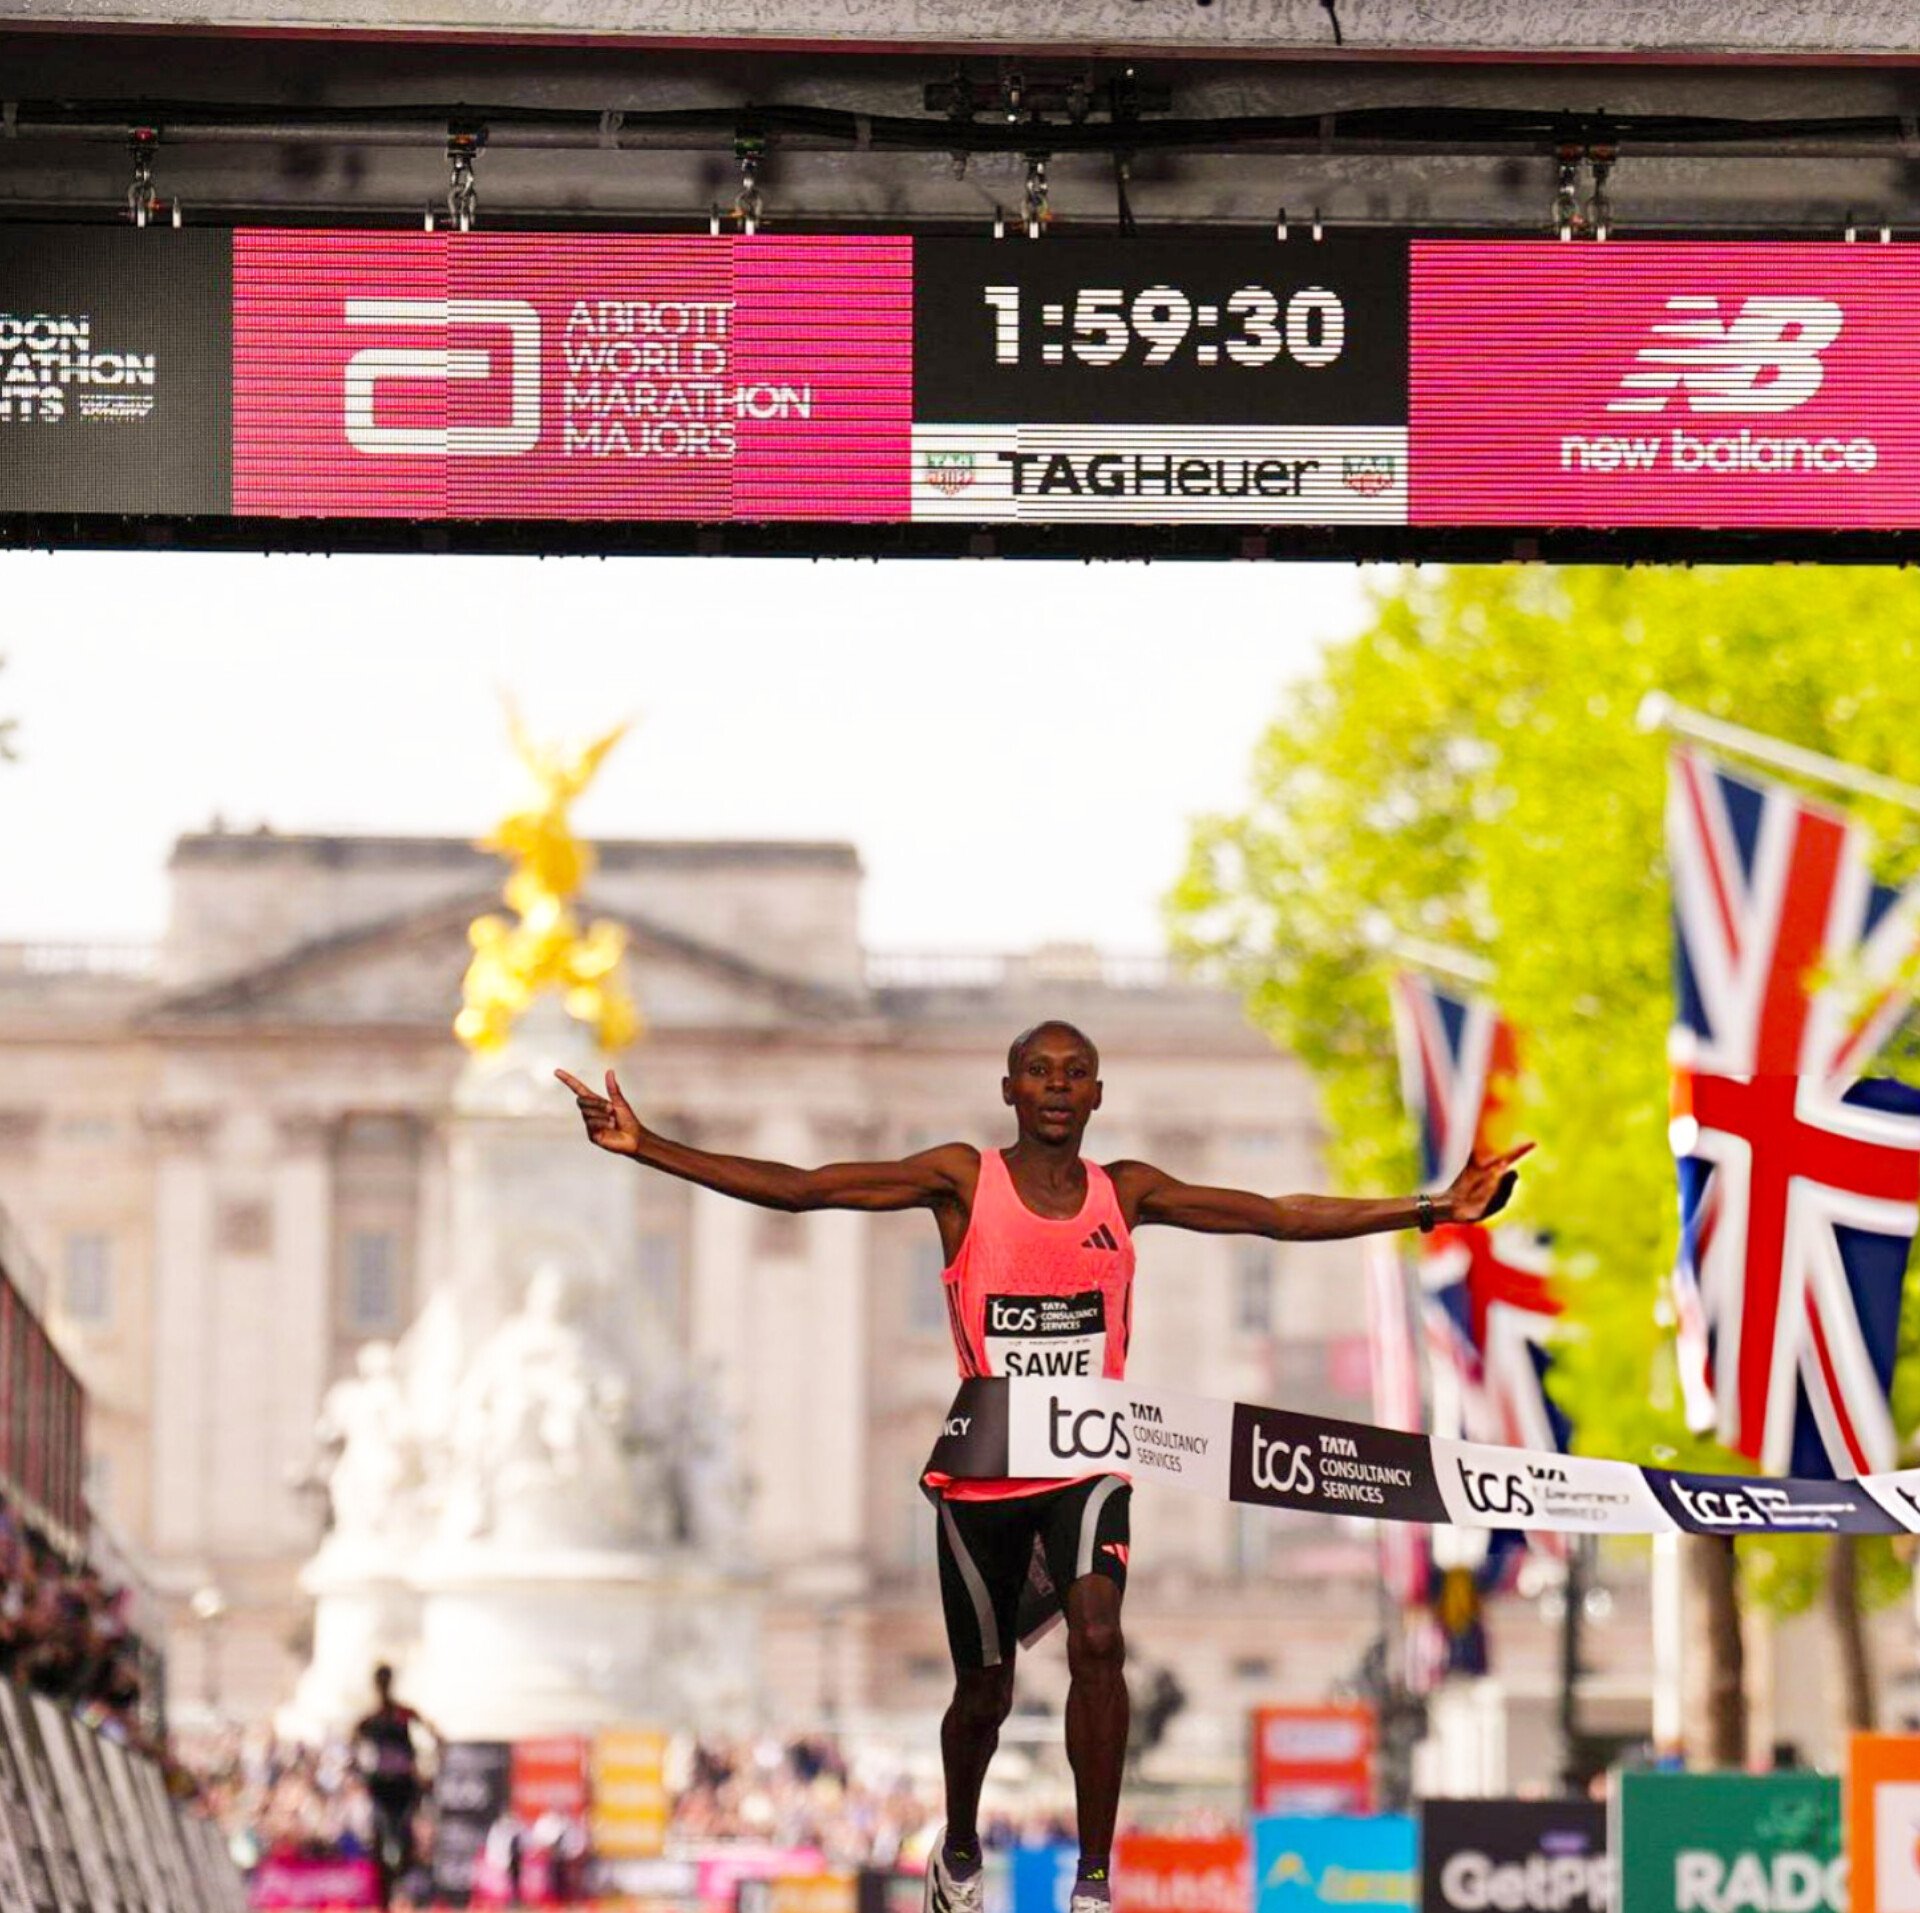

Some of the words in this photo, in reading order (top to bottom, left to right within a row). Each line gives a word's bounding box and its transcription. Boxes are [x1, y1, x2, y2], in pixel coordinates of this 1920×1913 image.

[564, 300, 736, 335] ABBOTT
[984, 285, 1345, 367] 1:59:30
[0, 351, 155, 385] ATHON
[563, 341, 727, 376] WORLD
[563, 382, 812, 419] MARATHON
[563, 420, 737, 457] MAJORS
[1560, 436, 1660, 470] new
[1672, 429, 1877, 472] balance
[992, 1301, 1037, 1331] tcs
[1041, 1302, 1068, 1311] TATA
[1005, 1349, 1090, 1377] SAWE
[1049, 1395, 1131, 1460] tcs
[1130, 1402, 1163, 1424] TATA
[1133, 1425, 1208, 1456] CONSULTANCY
[1319, 1434, 1358, 1458] TATA
[1137, 1450, 1182, 1473] SERVICES
[1251, 1423, 1315, 1495] tcs
[1319, 1457, 1412, 1488] CONSULTANCY
[1322, 1479, 1384, 1505] SERVICES
[1456, 1457, 1535, 1517] tcs
